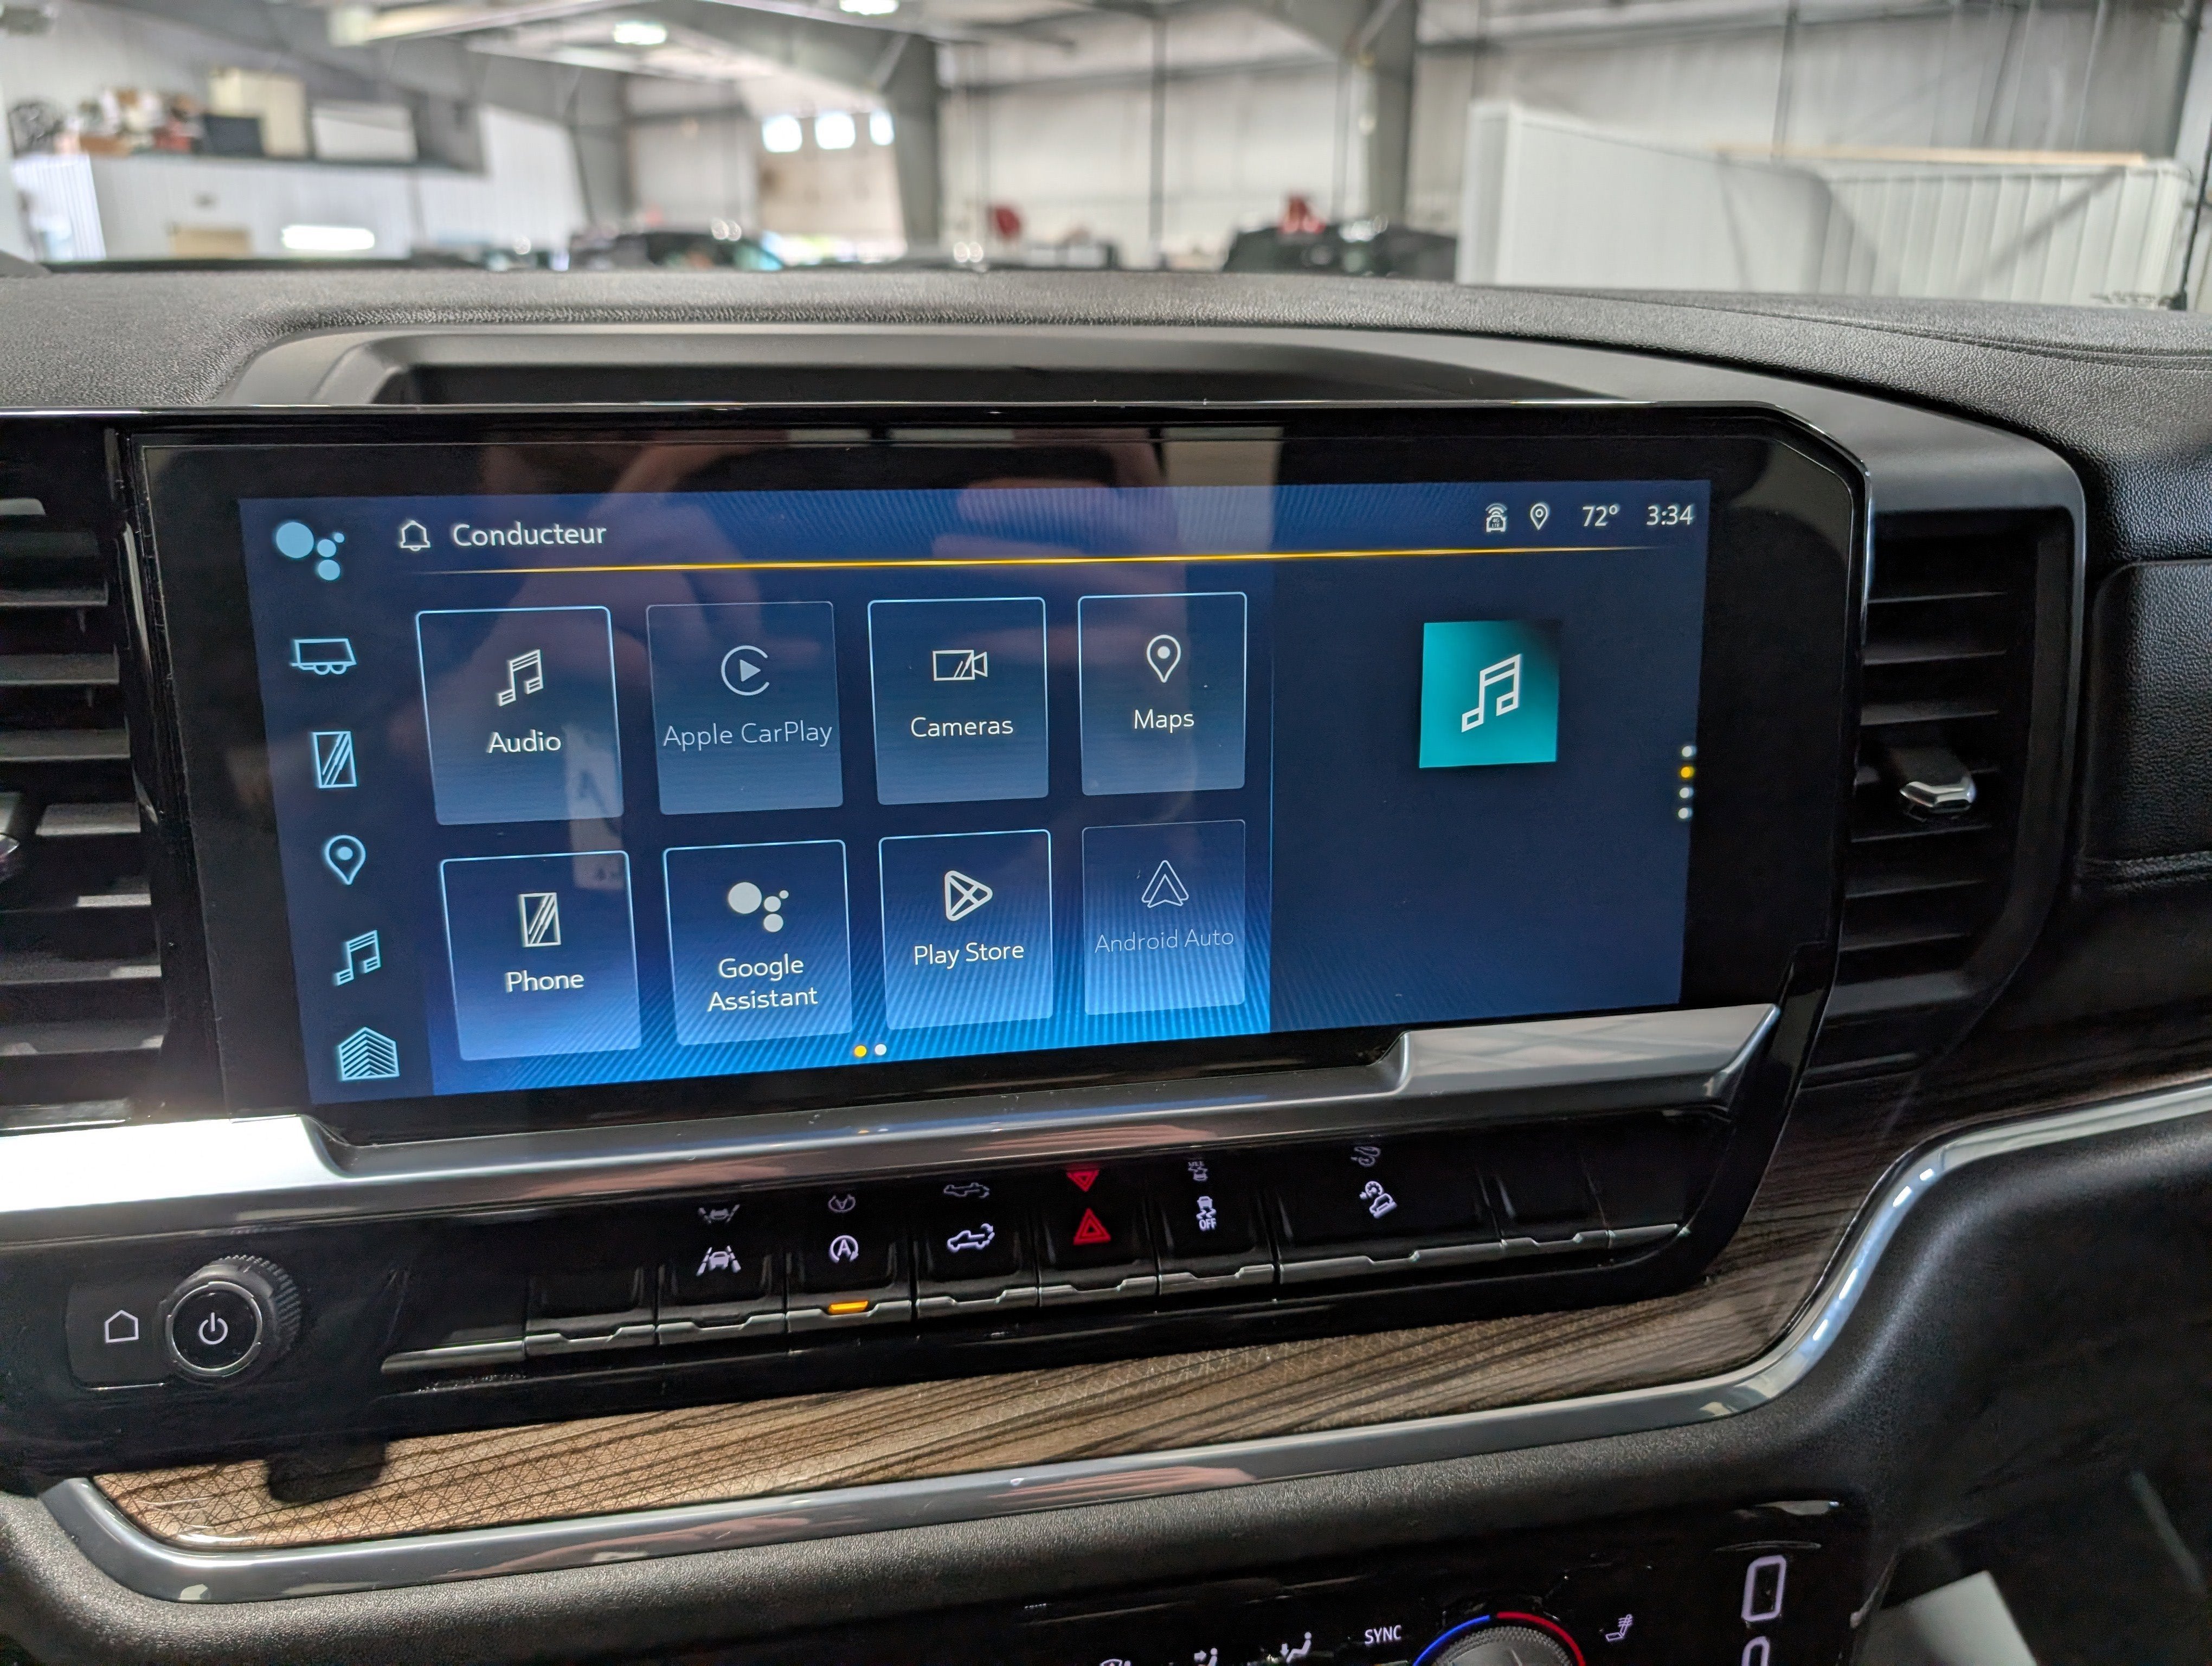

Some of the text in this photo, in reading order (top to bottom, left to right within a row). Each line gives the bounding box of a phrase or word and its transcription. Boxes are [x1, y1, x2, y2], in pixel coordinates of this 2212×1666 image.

[1583, 504, 1619, 527] 72°
[1647, 504, 1694, 526] 3:34
[452, 521, 607, 547] Conducteur
[911, 716, 1014, 738] Cameras
[1134, 708, 1195, 734] Maps
[487, 729, 561, 754] Audio
[663, 720, 833, 752] Apple CarPlay
[1095, 926, 1234, 953] Android Auto
[718, 953, 804, 982] Google
[914, 941, 1025, 970] Play Store
[505, 969, 584, 993] Phone
[706, 985, 818, 1012] Assistant
[1199, 1218, 1216, 1231] OFF
[1364, 1624, 1401, 1645] SYNC
